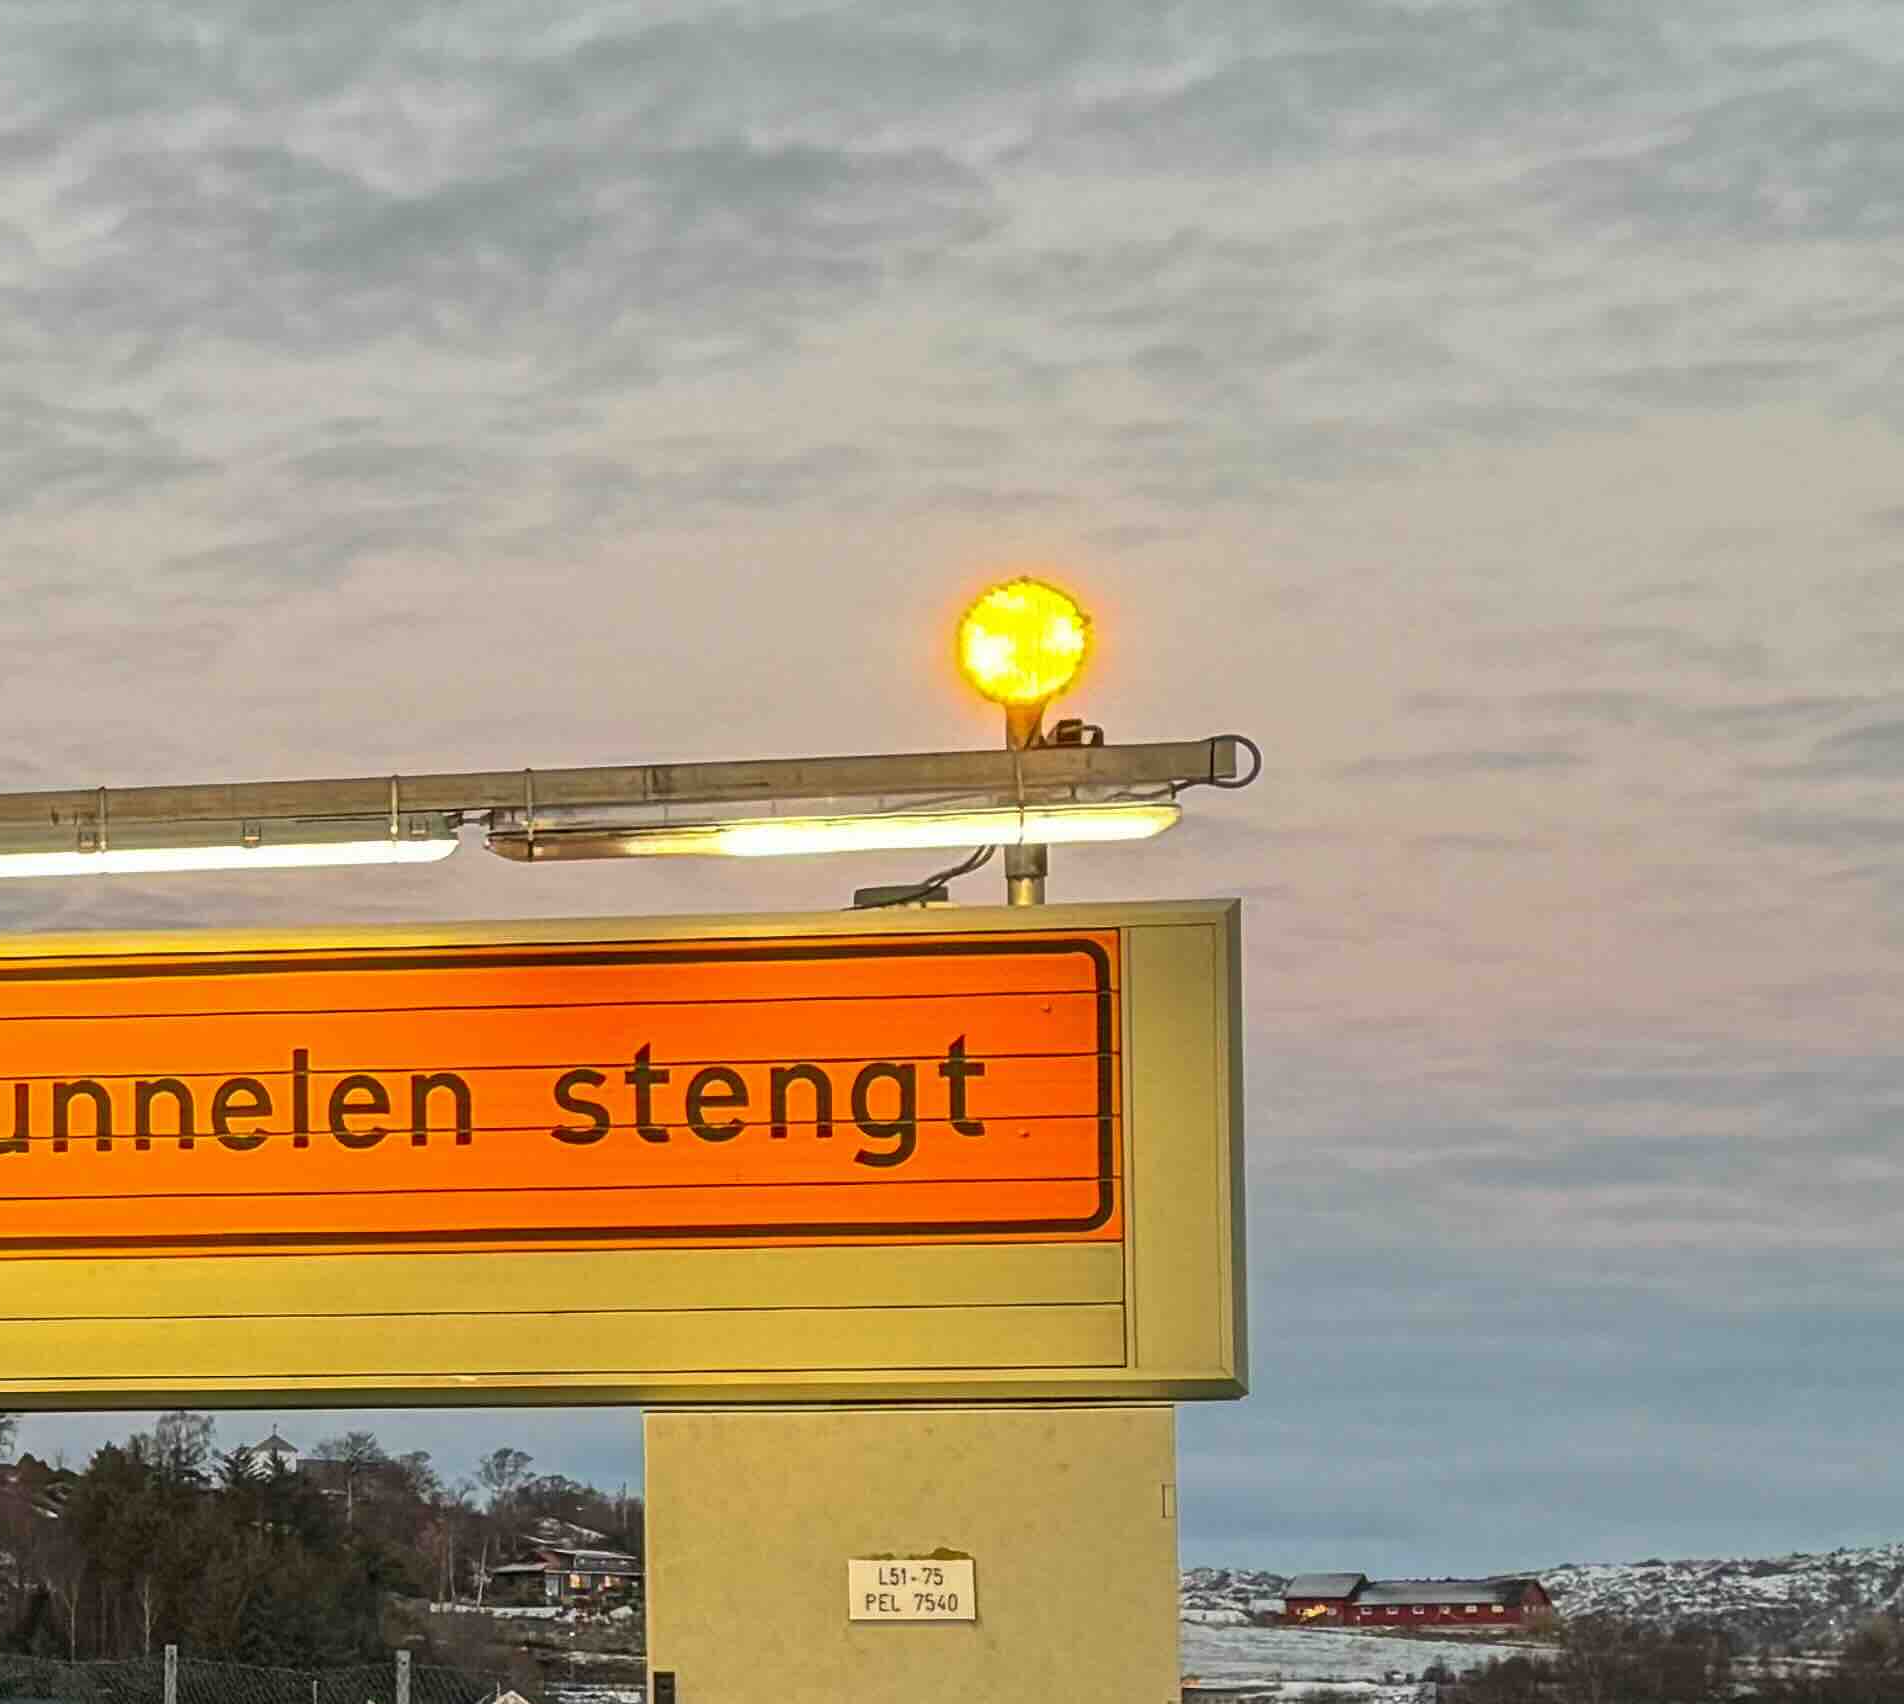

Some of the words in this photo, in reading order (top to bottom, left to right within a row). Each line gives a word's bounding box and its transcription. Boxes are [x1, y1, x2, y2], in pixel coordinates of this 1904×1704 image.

[550, 1033, 986, 1168] stengt
[864, 1592, 901, 1613] PEL
[913, 1592, 959, 1613] 7540
